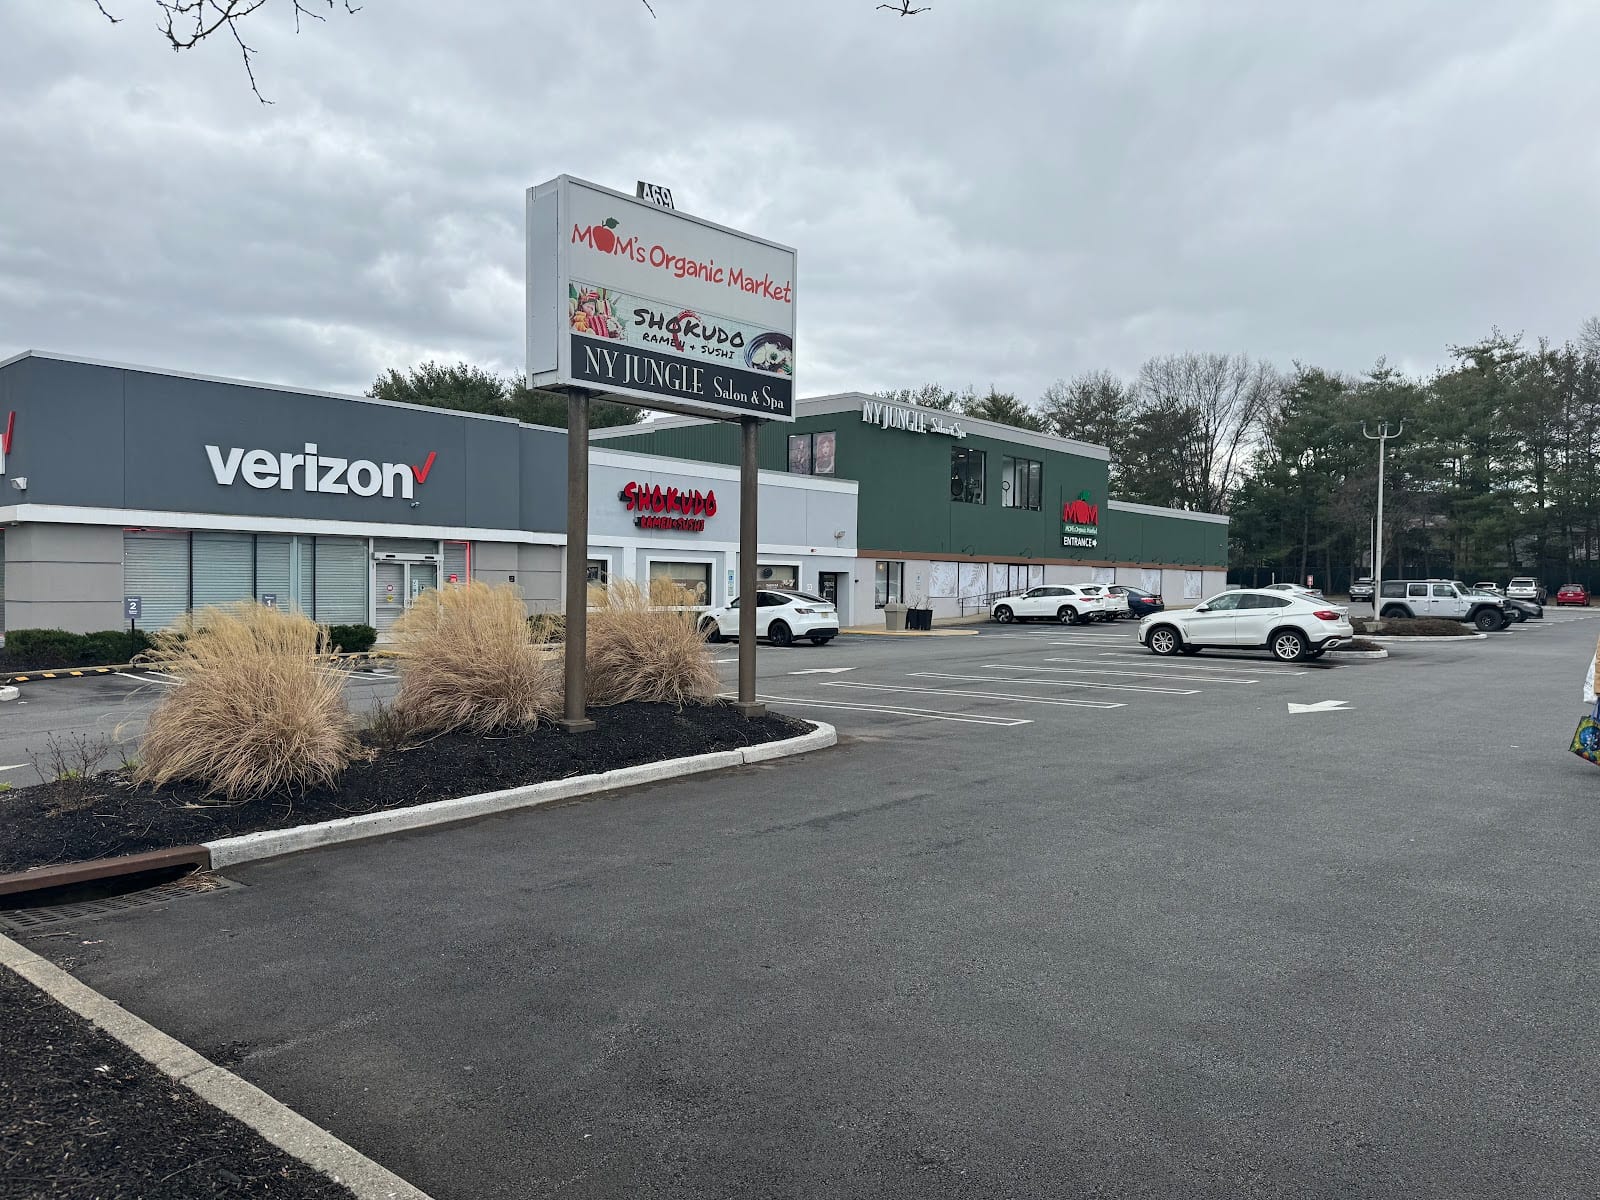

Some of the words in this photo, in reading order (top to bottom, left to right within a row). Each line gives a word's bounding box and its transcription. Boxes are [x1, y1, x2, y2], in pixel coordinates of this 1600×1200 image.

[643, 183, 674, 209] 469
[649, 245, 724, 283] Organic
[727, 267, 791, 303] Market
[633, 308, 745, 348] SHOKUDO
[700, 345, 735, 360] SUSHI
[583, 344, 620, 379] NY
[622, 353, 704, 395] JUNGLE
[713, 375, 748, 403] Salon
[750, 390, 760, 405] &
[762, 385, 785, 410] Spa
[862, 400, 882, 424] NY
[881, 405, 927, 434] JUNGLE
[204, 442, 414, 499] verizon
[623, 481, 717, 517] SHOKUDO
[1064, 536, 1092, 547] ENTRANCE
[130, 602, 137, 610] 2
